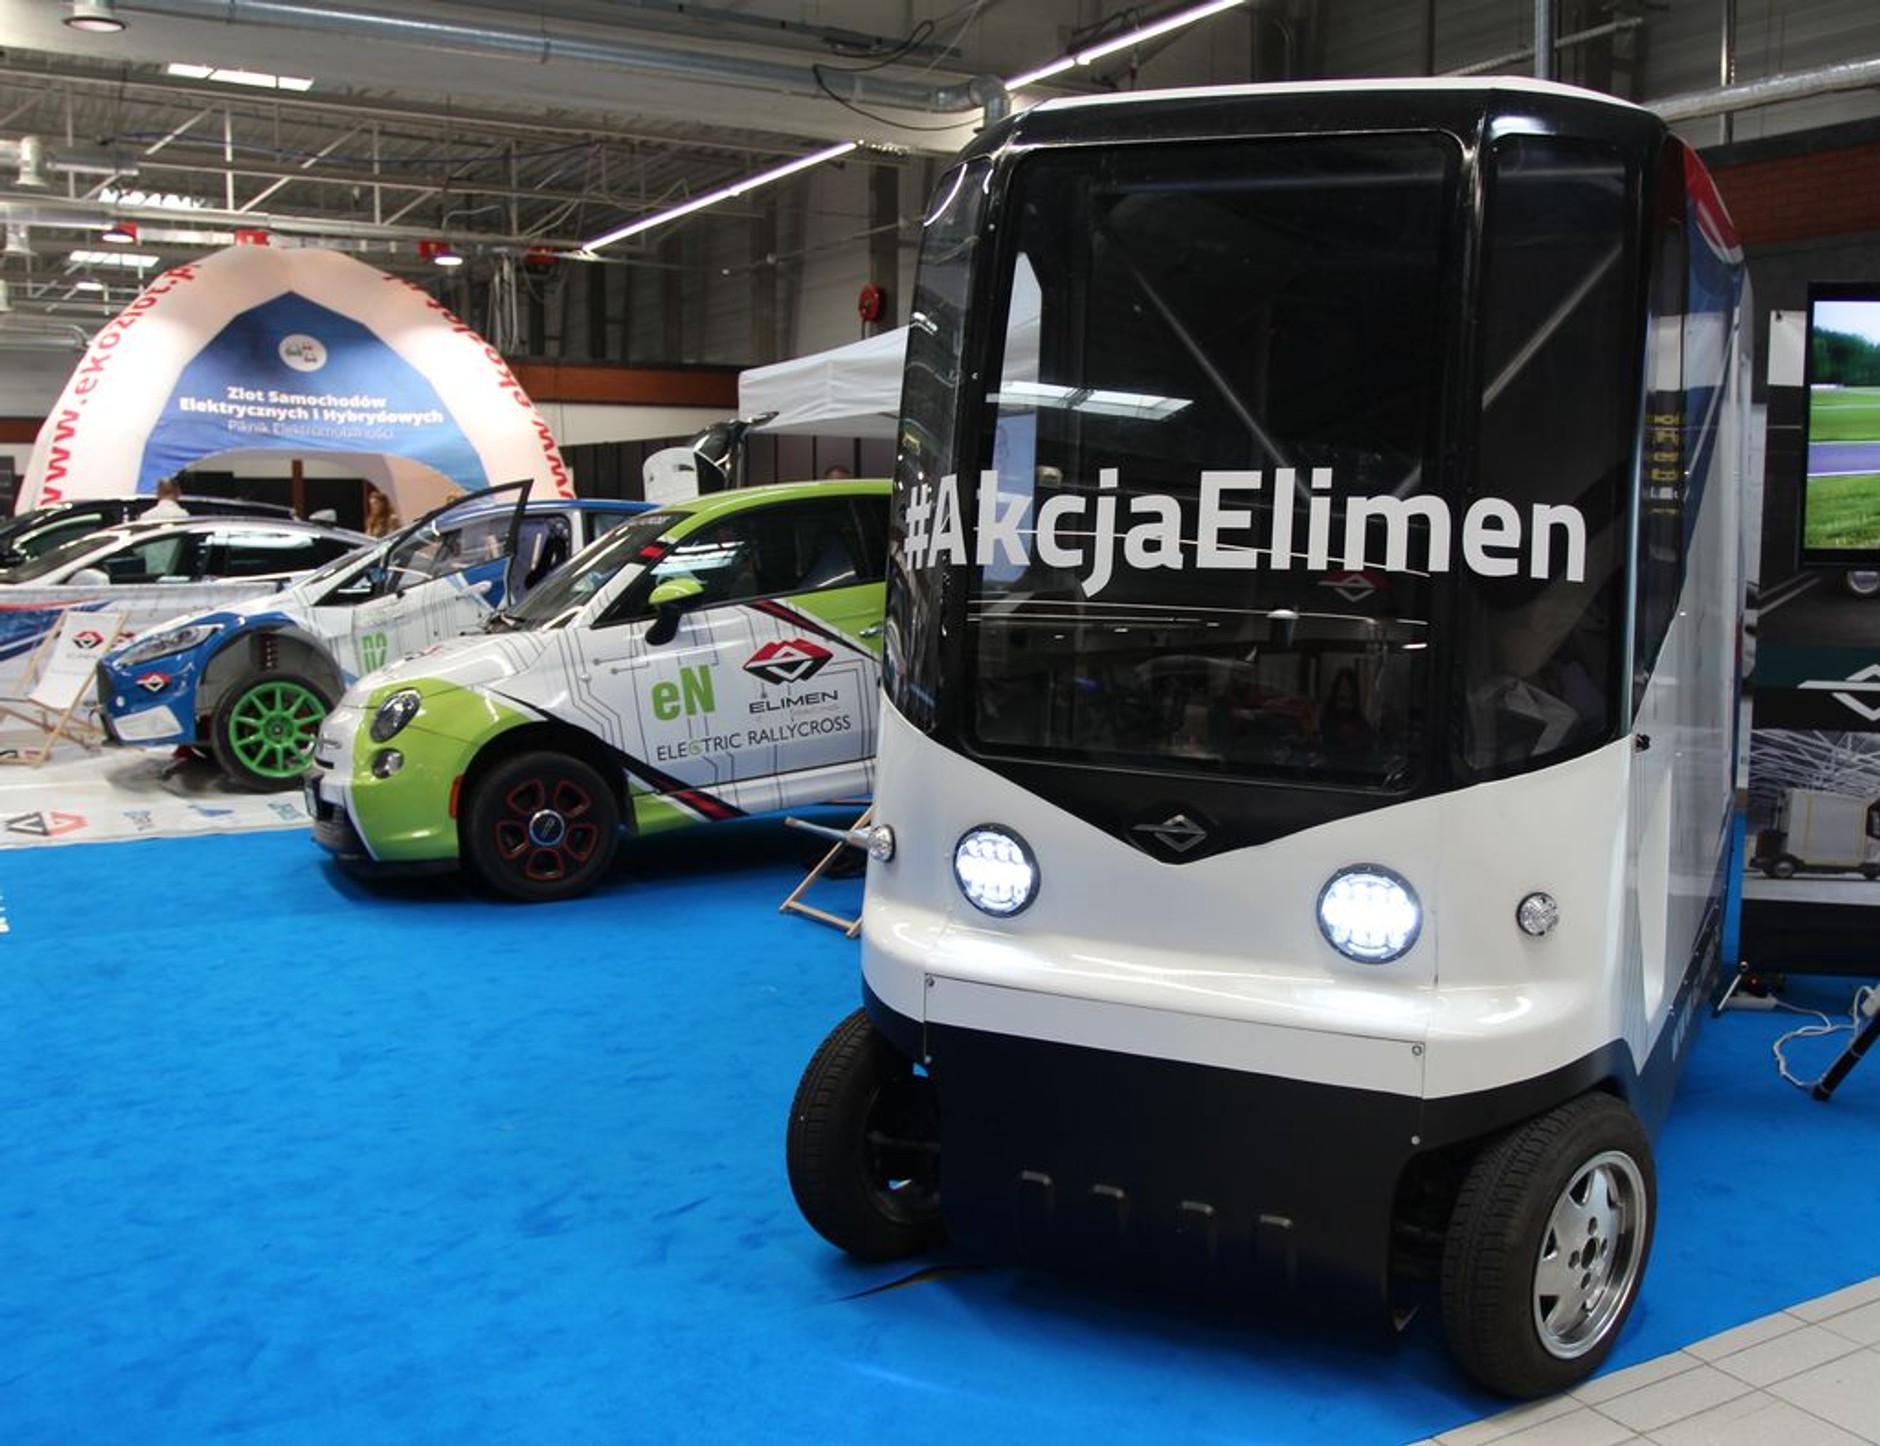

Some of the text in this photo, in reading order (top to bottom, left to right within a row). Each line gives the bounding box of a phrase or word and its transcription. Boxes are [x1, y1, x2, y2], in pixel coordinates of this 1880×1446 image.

[179, 397, 308, 422] Elektrycznych
[323, 408, 444, 427] Hybrydowych
[227, 386, 387, 408] Zlot Samochodów
[903, 467, 1587, 598] #AkcjaElimen
[651, 664, 715, 722] eN
[749, 690, 839, 714] ELIMEN
[657, 714, 852, 761] ELECTRIC RALLYCROSS
